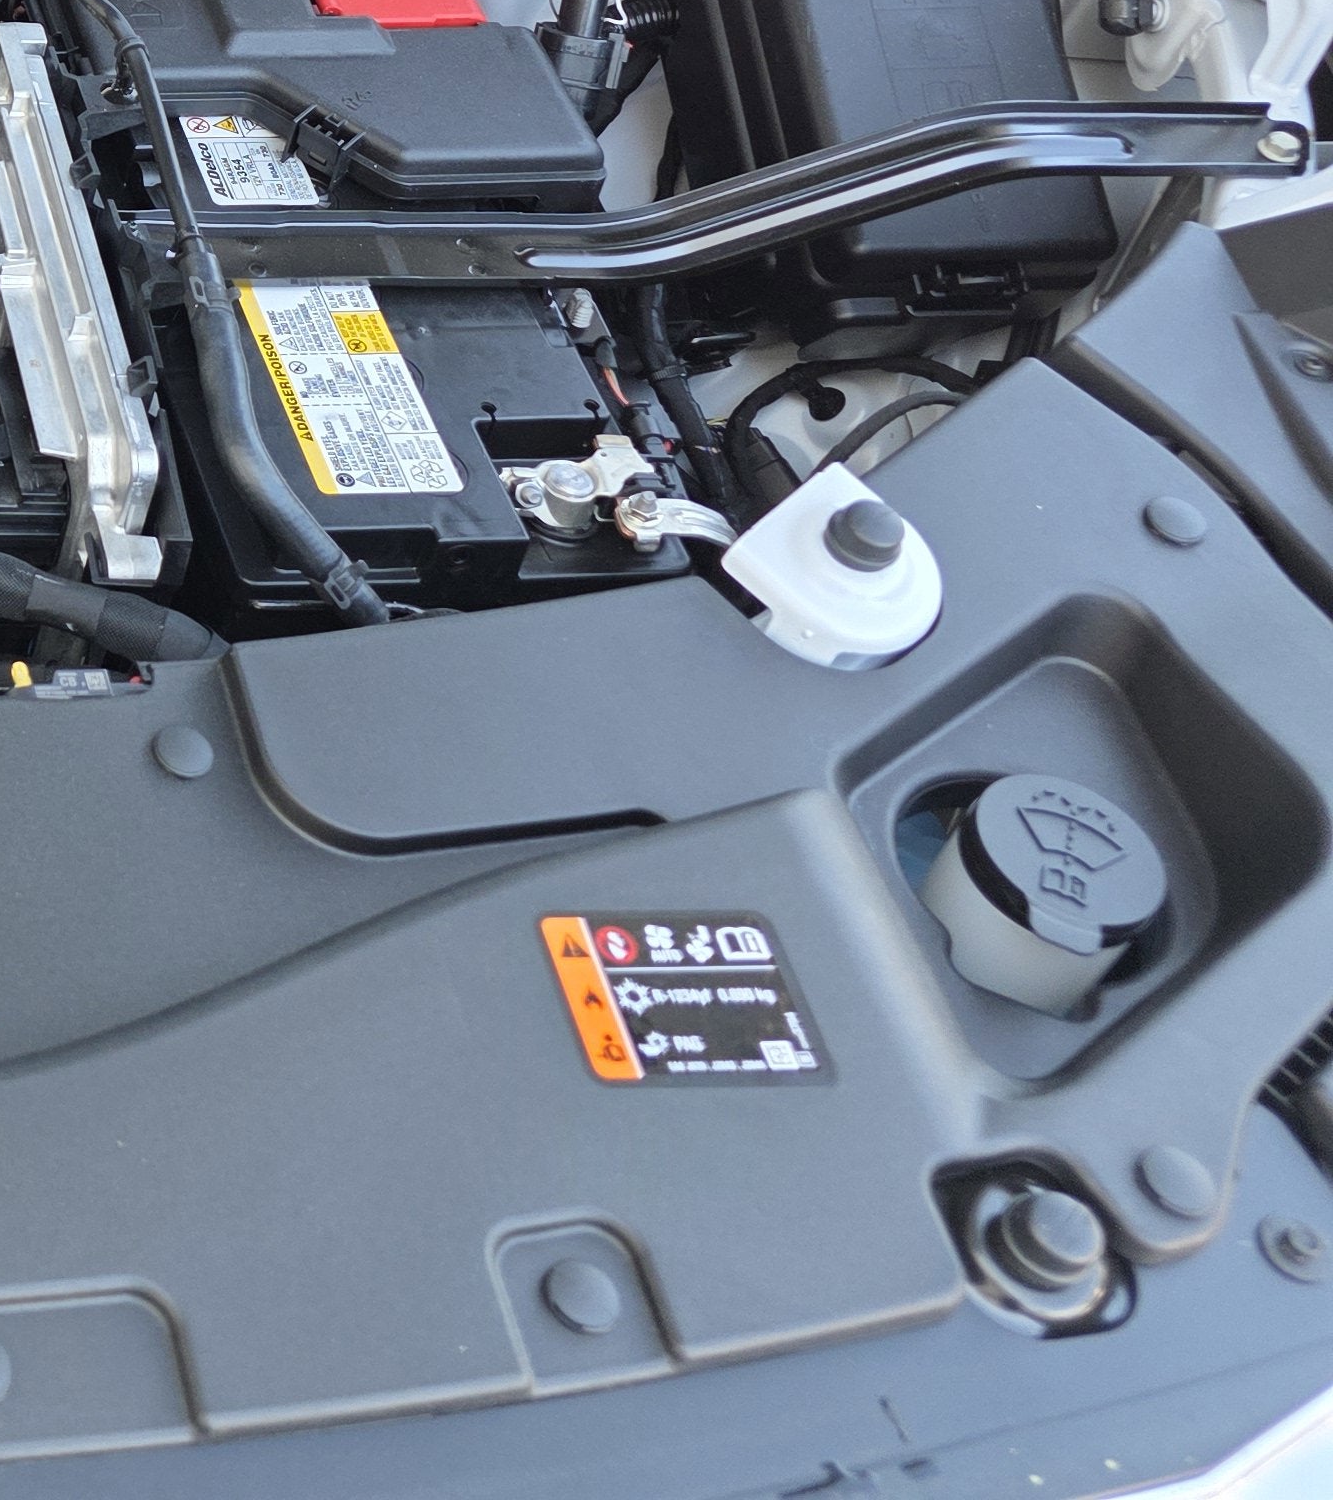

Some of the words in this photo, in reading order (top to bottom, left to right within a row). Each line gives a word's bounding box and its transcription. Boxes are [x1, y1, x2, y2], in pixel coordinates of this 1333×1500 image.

[194, 142, 228, 196] ACDelco
[230, 158, 250, 182] 9354
[258, 334, 308, 430] DANGER/POISON
[59, 677, 78, 687] CB
